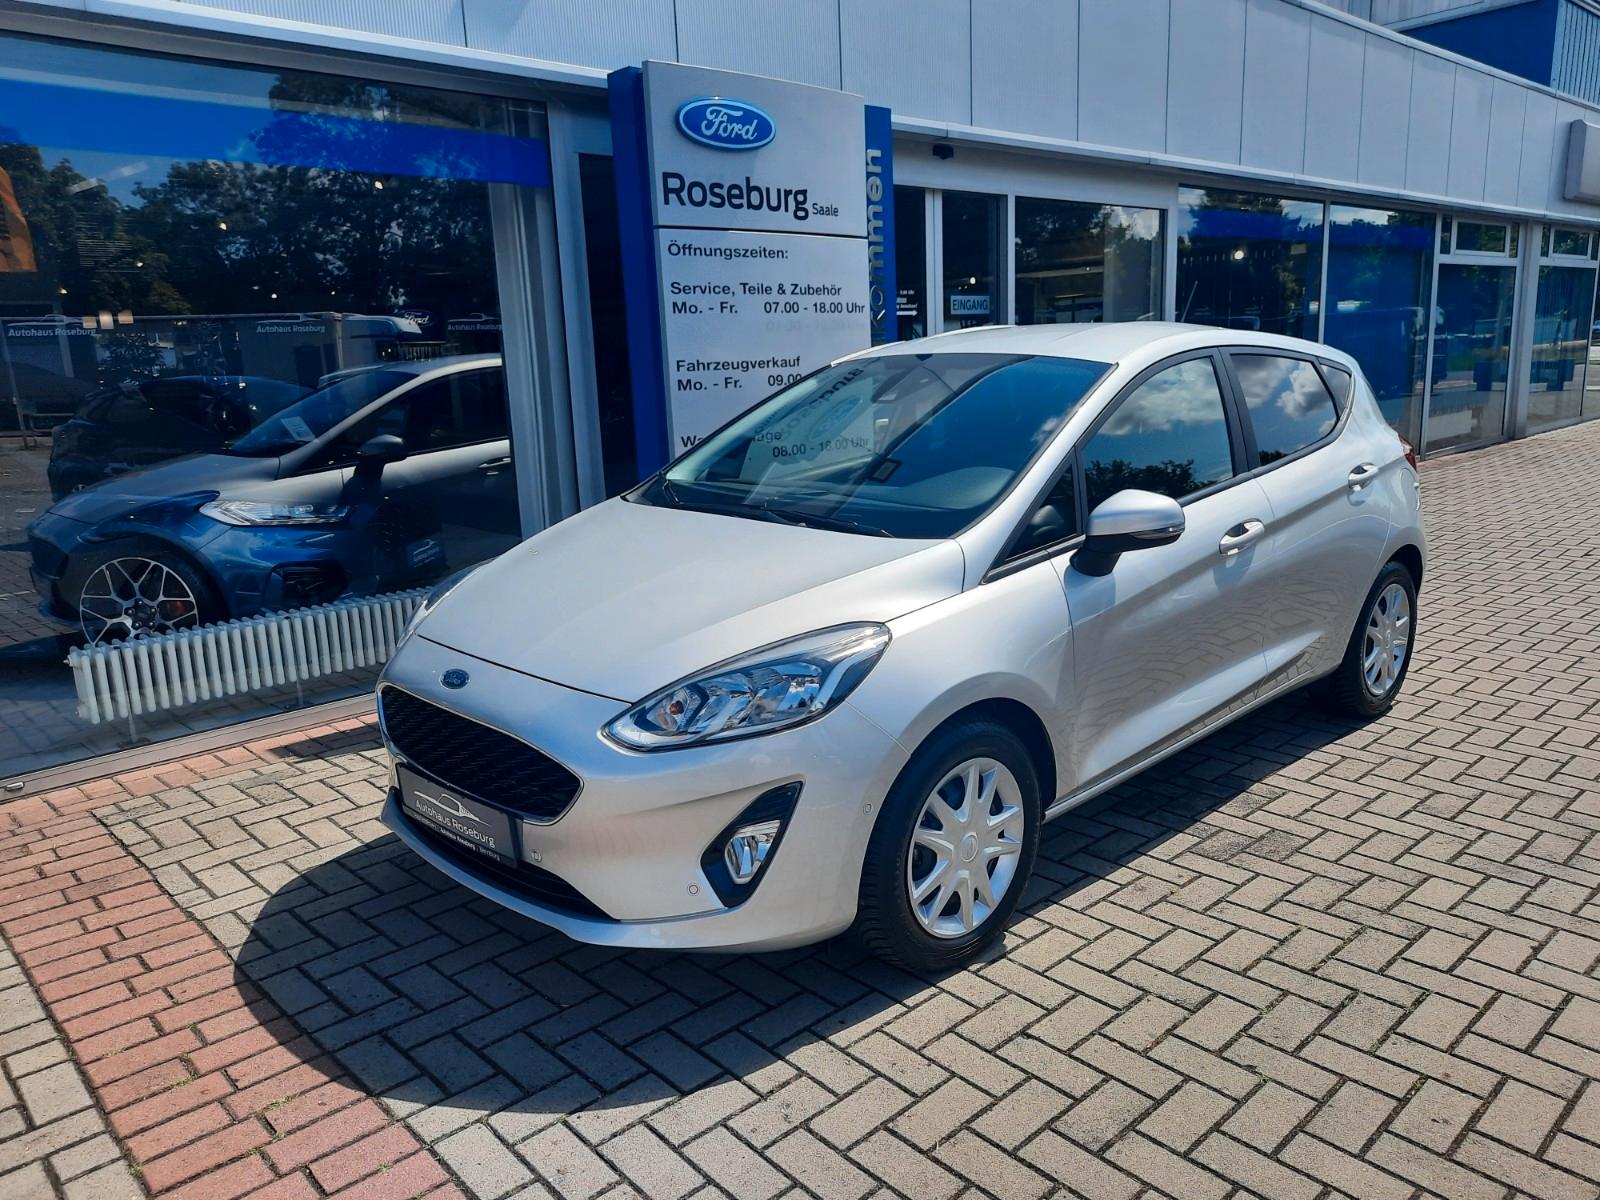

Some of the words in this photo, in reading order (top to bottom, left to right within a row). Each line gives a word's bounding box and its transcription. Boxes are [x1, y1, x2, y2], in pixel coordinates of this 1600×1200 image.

[701, 106, 757, 141] Ford
[661, 171, 809, 220] Roseburg
[812, 203, 839, 217] Saale
[667, 241, 789, 261] Öffnungszeiten:
[670, 281, 736, 297] Service,
[740, 282, 773, 296] Teile
[777, 283, 787, 296] &
[790, 283, 842, 297] Zubehör
[672, 301, 703, 314] Mo.
[719, 301, 738, 314] Fr.
[763, 301, 800, 314] 07.00
[812, 302, 843, 314] 18.00
[846, 302, 865, 314] Uhr
[952, 298, 988, 312] EINGANG
[8, 328, 54, 337] Autohaus
[54, 327, 97, 337] Roseburg
[256, 325, 292, 333] Autohaus
[676, 355, 801, 372] Fahrzeugverkauf
[677, 378, 708, 392] Mo.
[724, 376, 742, 389] Fr.
[772, 443, 807, 458] 08.00
[416, 799, 452, 827] Autohaus
[452, 818, 496, 849] Roseburg
